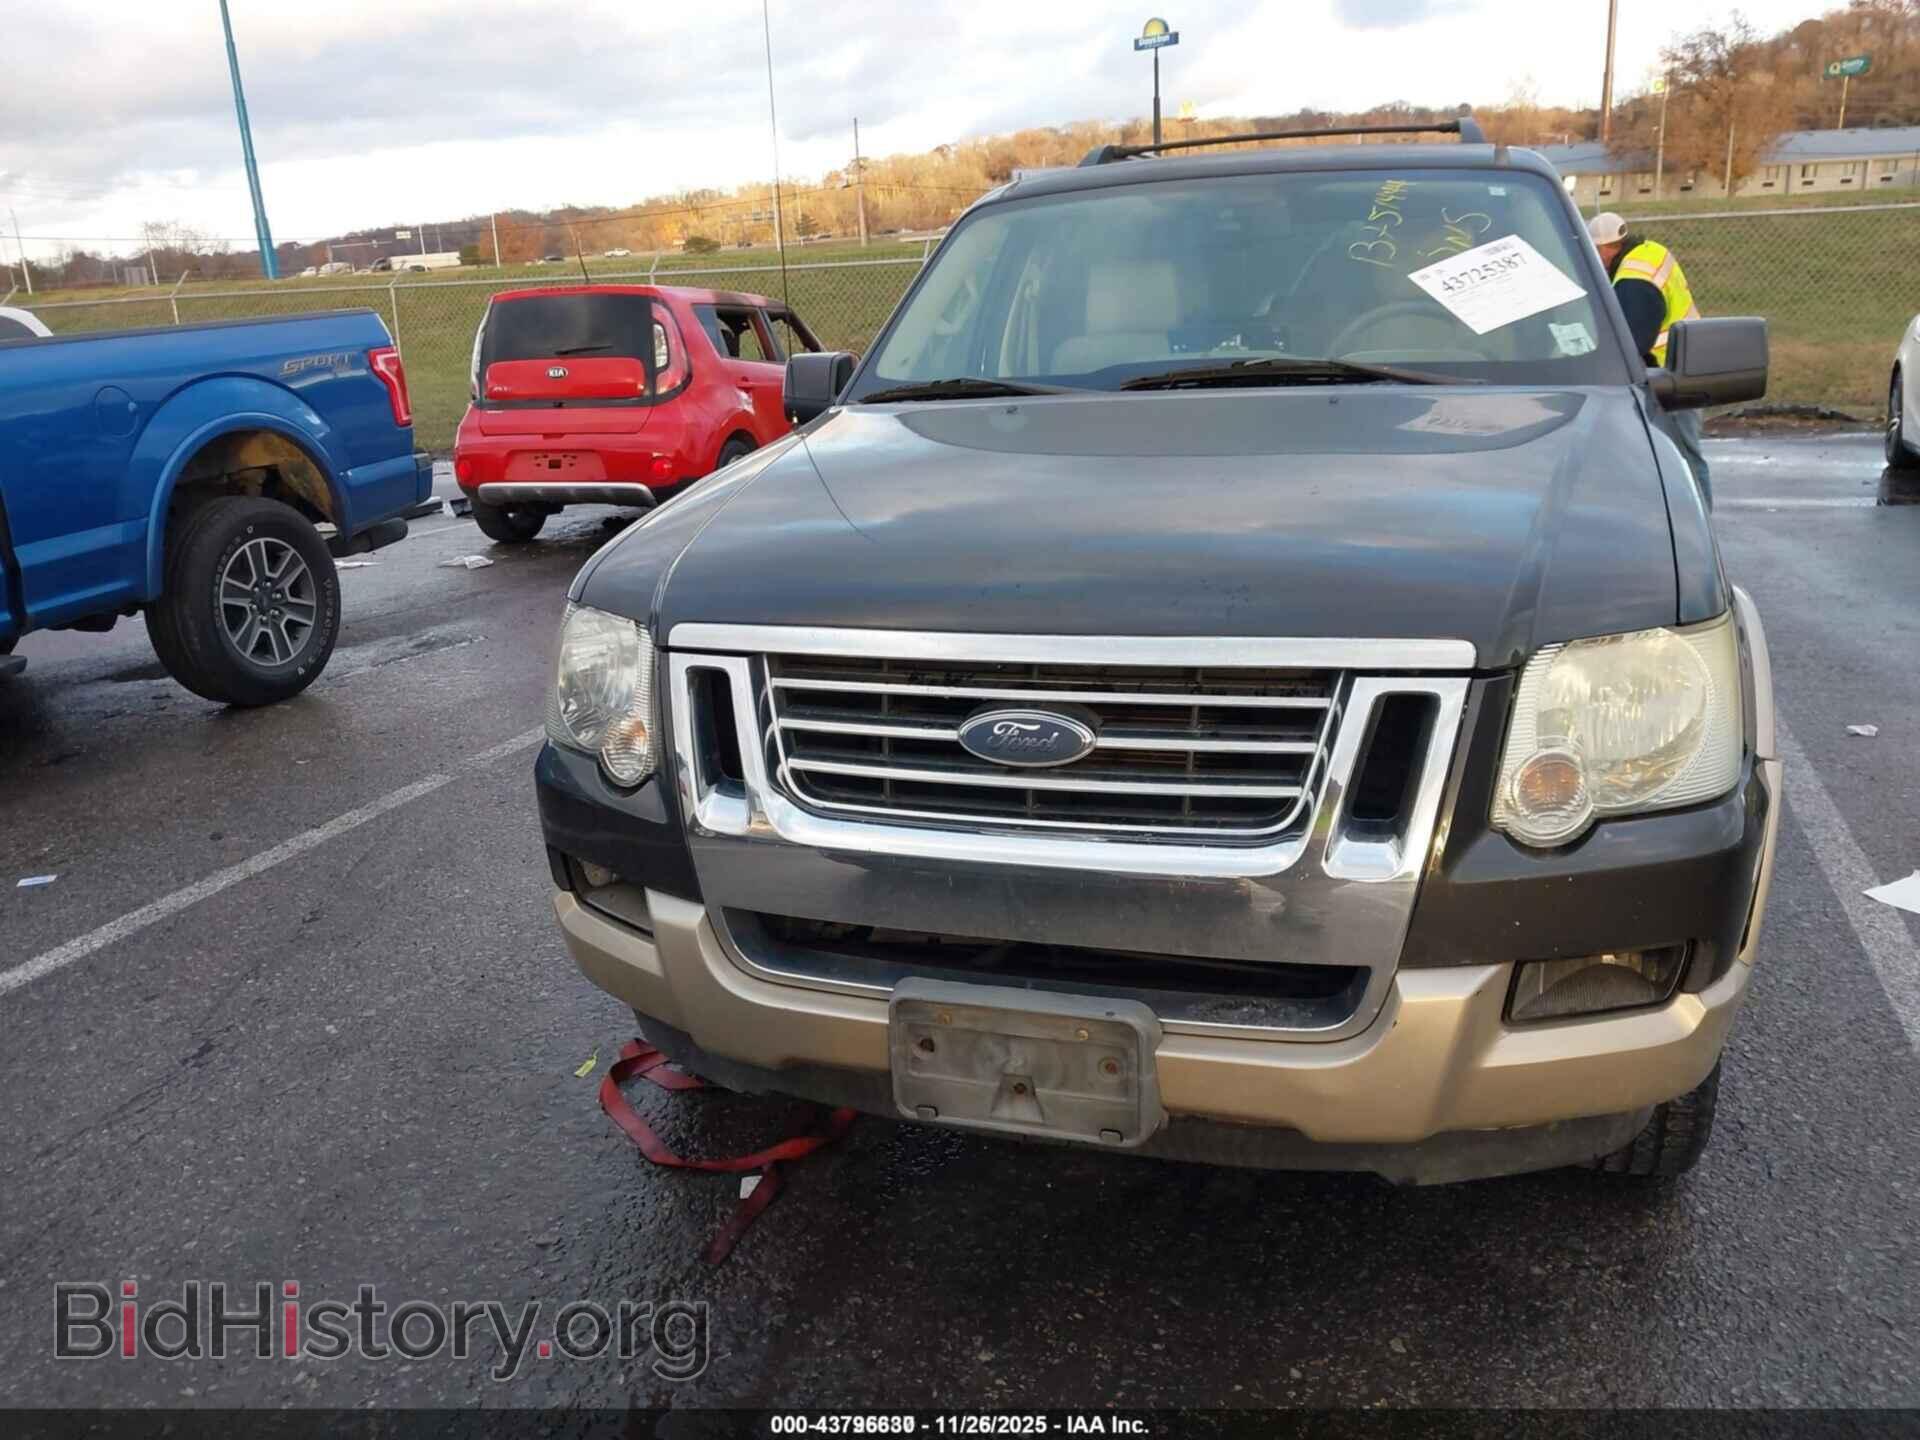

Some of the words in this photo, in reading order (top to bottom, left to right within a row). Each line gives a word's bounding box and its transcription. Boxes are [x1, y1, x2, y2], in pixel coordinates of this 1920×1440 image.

[1440, 252, 1529, 293] 43725387
[282, 351, 355, 375] SPORT
[986, 720, 1060, 749] Ford
